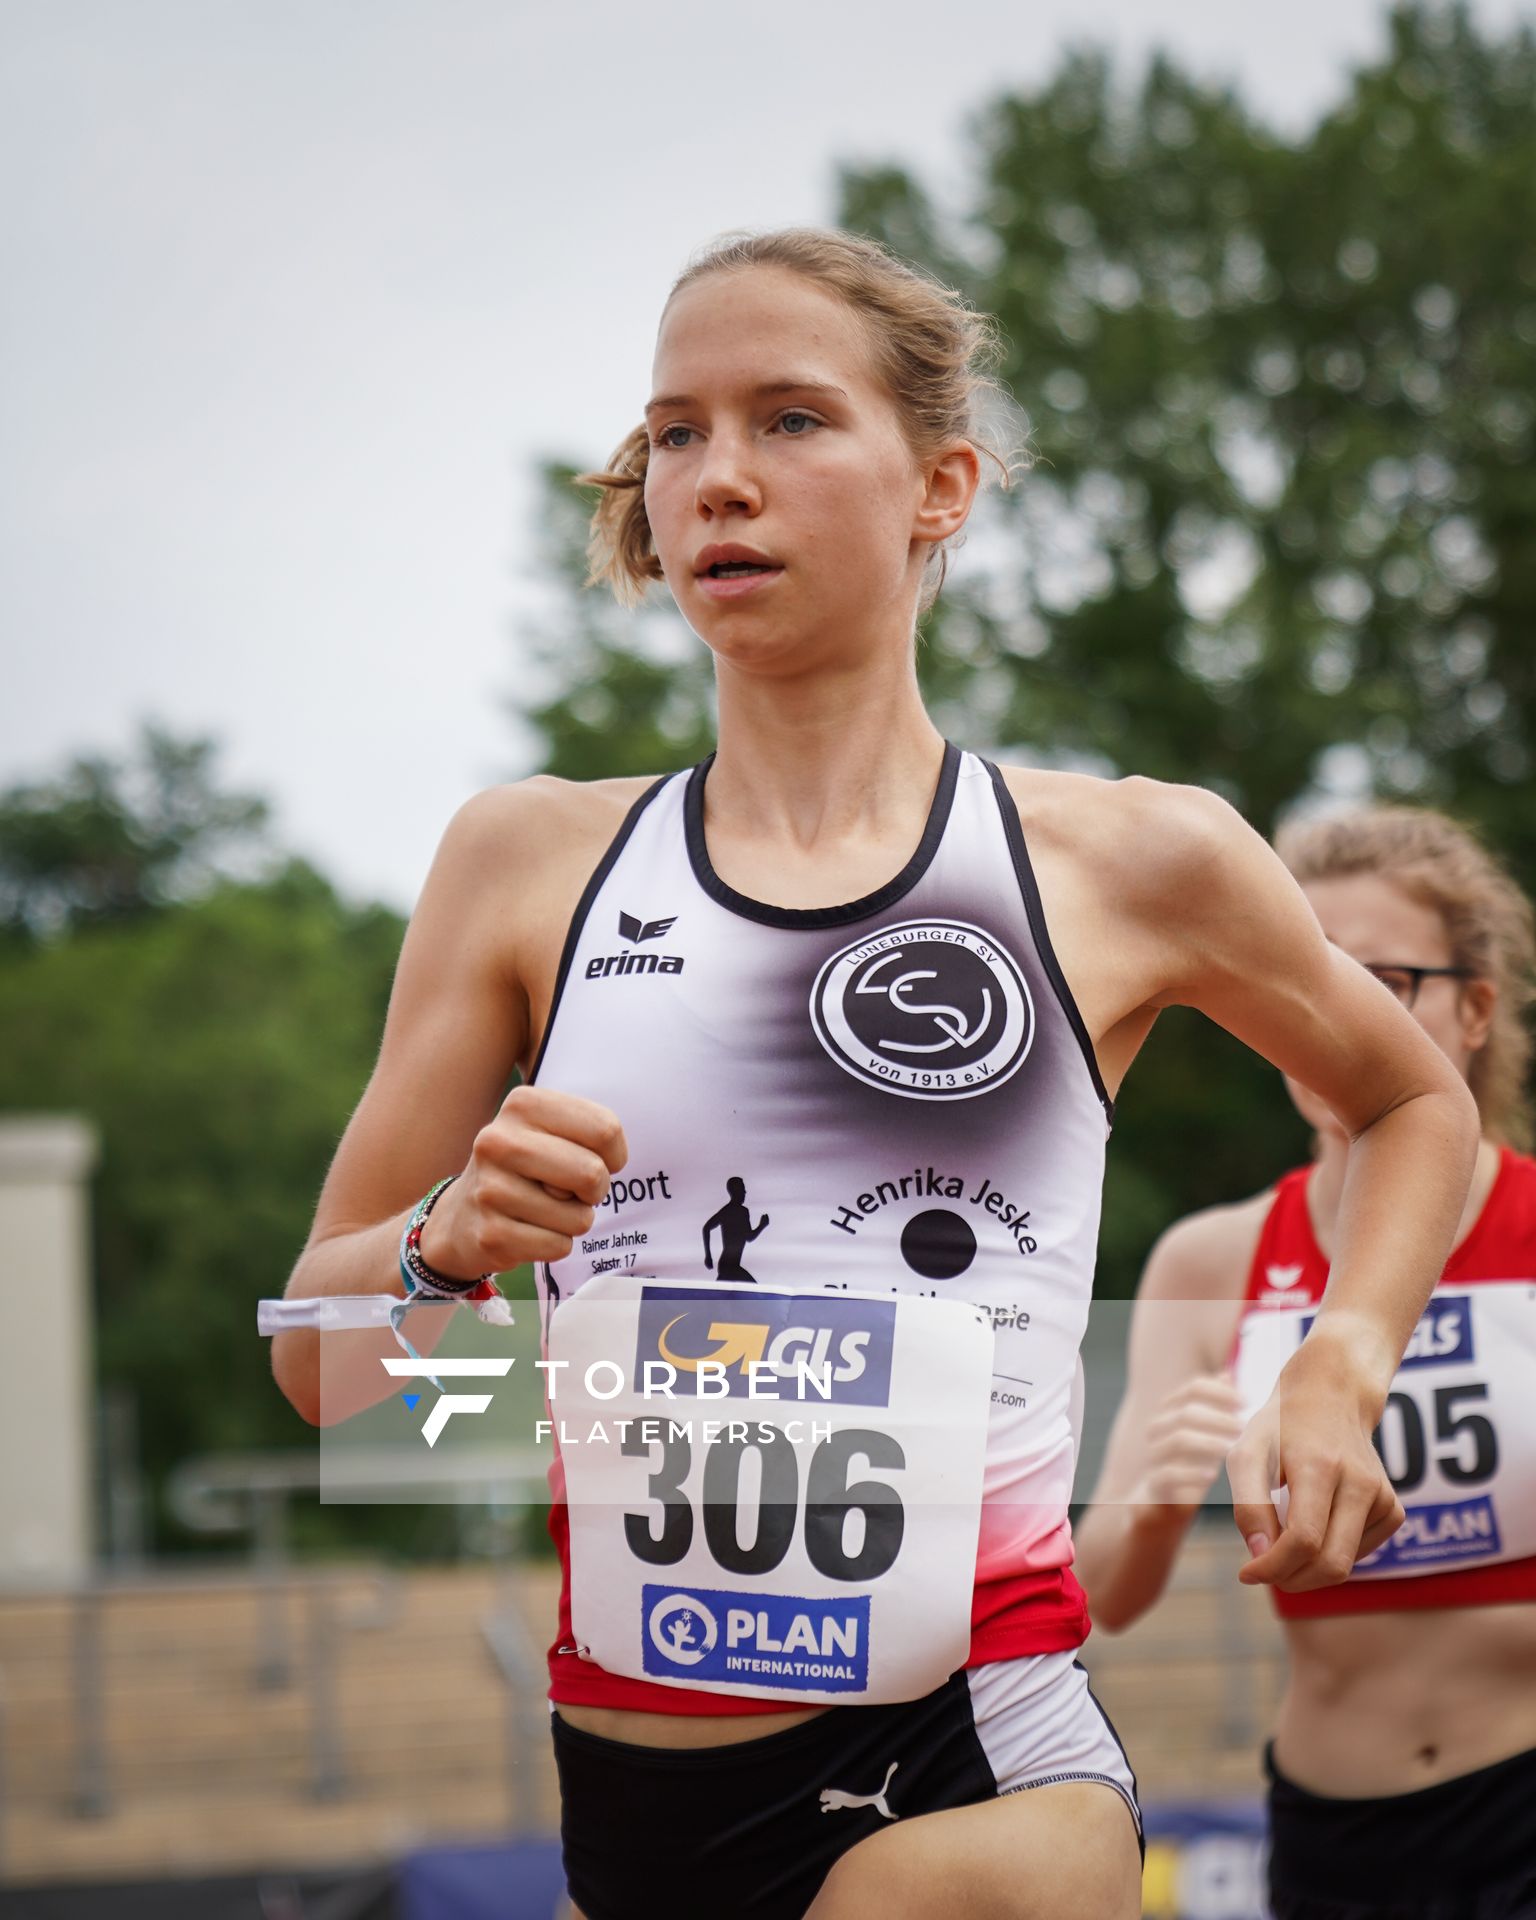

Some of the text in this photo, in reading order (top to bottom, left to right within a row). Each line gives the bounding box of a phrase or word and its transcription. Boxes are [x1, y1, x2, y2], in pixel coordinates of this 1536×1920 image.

[584, 949, 685, 980] erima
[846, 930, 998, 966] LÜNEBURGER SV
[868, 1058, 996, 1087] von 1913 e.V.
[829, 1166, 1038, 1256] Henrika Jeske
[581, 1230, 648, 1255] Rainer Jahnke
[624, 1253, 637, 1268] 17
[767, 1325, 872, 1382] GLS
[620, 1416, 907, 1582] 306
[726, 1608, 859, 1658] PLAN
[726, 1656, 856, 1680] INTERNATIONAL
